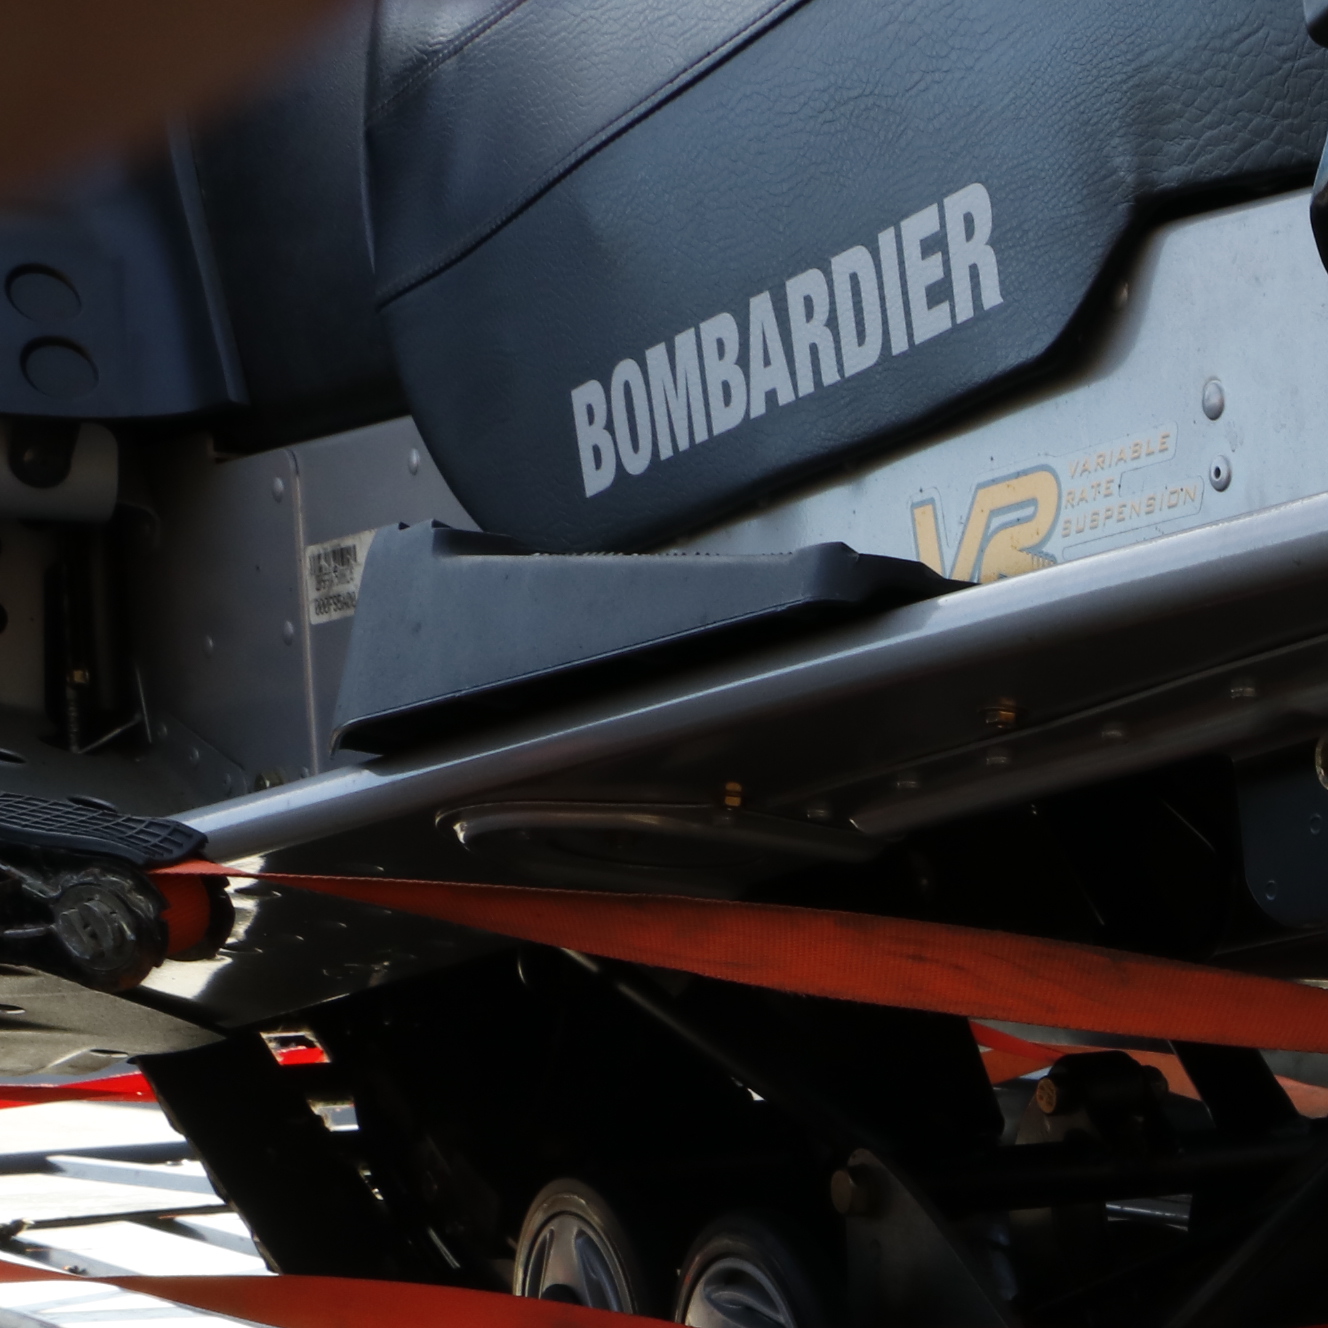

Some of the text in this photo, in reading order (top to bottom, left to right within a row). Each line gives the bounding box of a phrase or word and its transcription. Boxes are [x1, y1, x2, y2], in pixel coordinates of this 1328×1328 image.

[571, 182, 1004, 499] BOMBARDIER
[1069, 432, 1170, 479] VARIABLE
[1061, 484, 1197, 538] SUSPENSION
[1064, 478, 1115, 509] RATE
